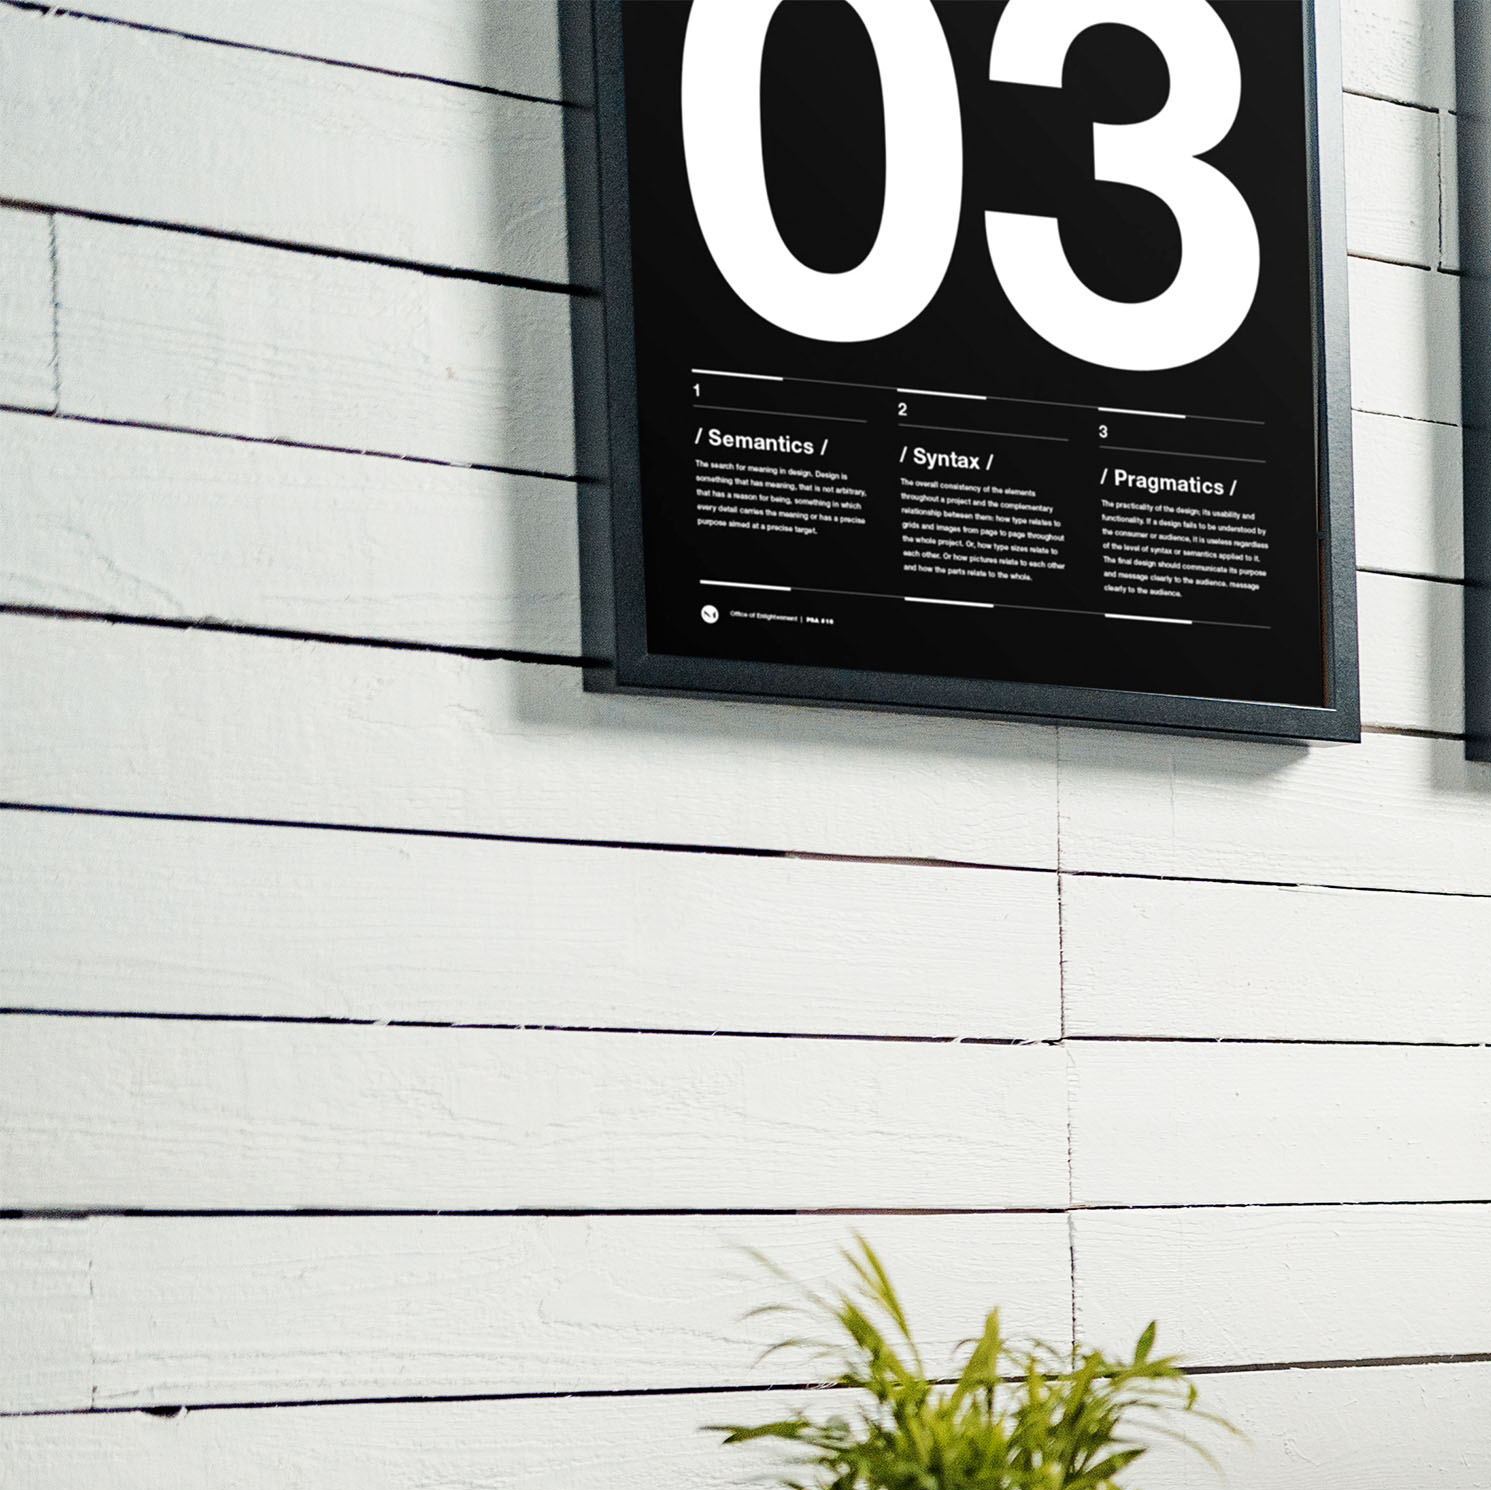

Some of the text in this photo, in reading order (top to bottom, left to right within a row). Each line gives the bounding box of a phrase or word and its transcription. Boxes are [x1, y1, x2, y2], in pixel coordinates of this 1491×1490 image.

[681, 0, 1260, 371] 03
[693, 383, 699, 396] 1
[898, 402, 906, 415] 2
[708, 428, 813, 454] Semantics
[1098, 424, 1107, 438] 3
[913, 447, 979, 469] Syntax
[695, 459, 708, 467] The
[747, 465, 777, 475] meaning
[787, 468, 812, 478] design.
[815, 469, 839, 480] Design
[734, 477, 748, 485] that
[764, 481, 797, 491] meaning,
[798, 483, 812, 491] that
[1114, 468, 1223, 494] Pragmatics
